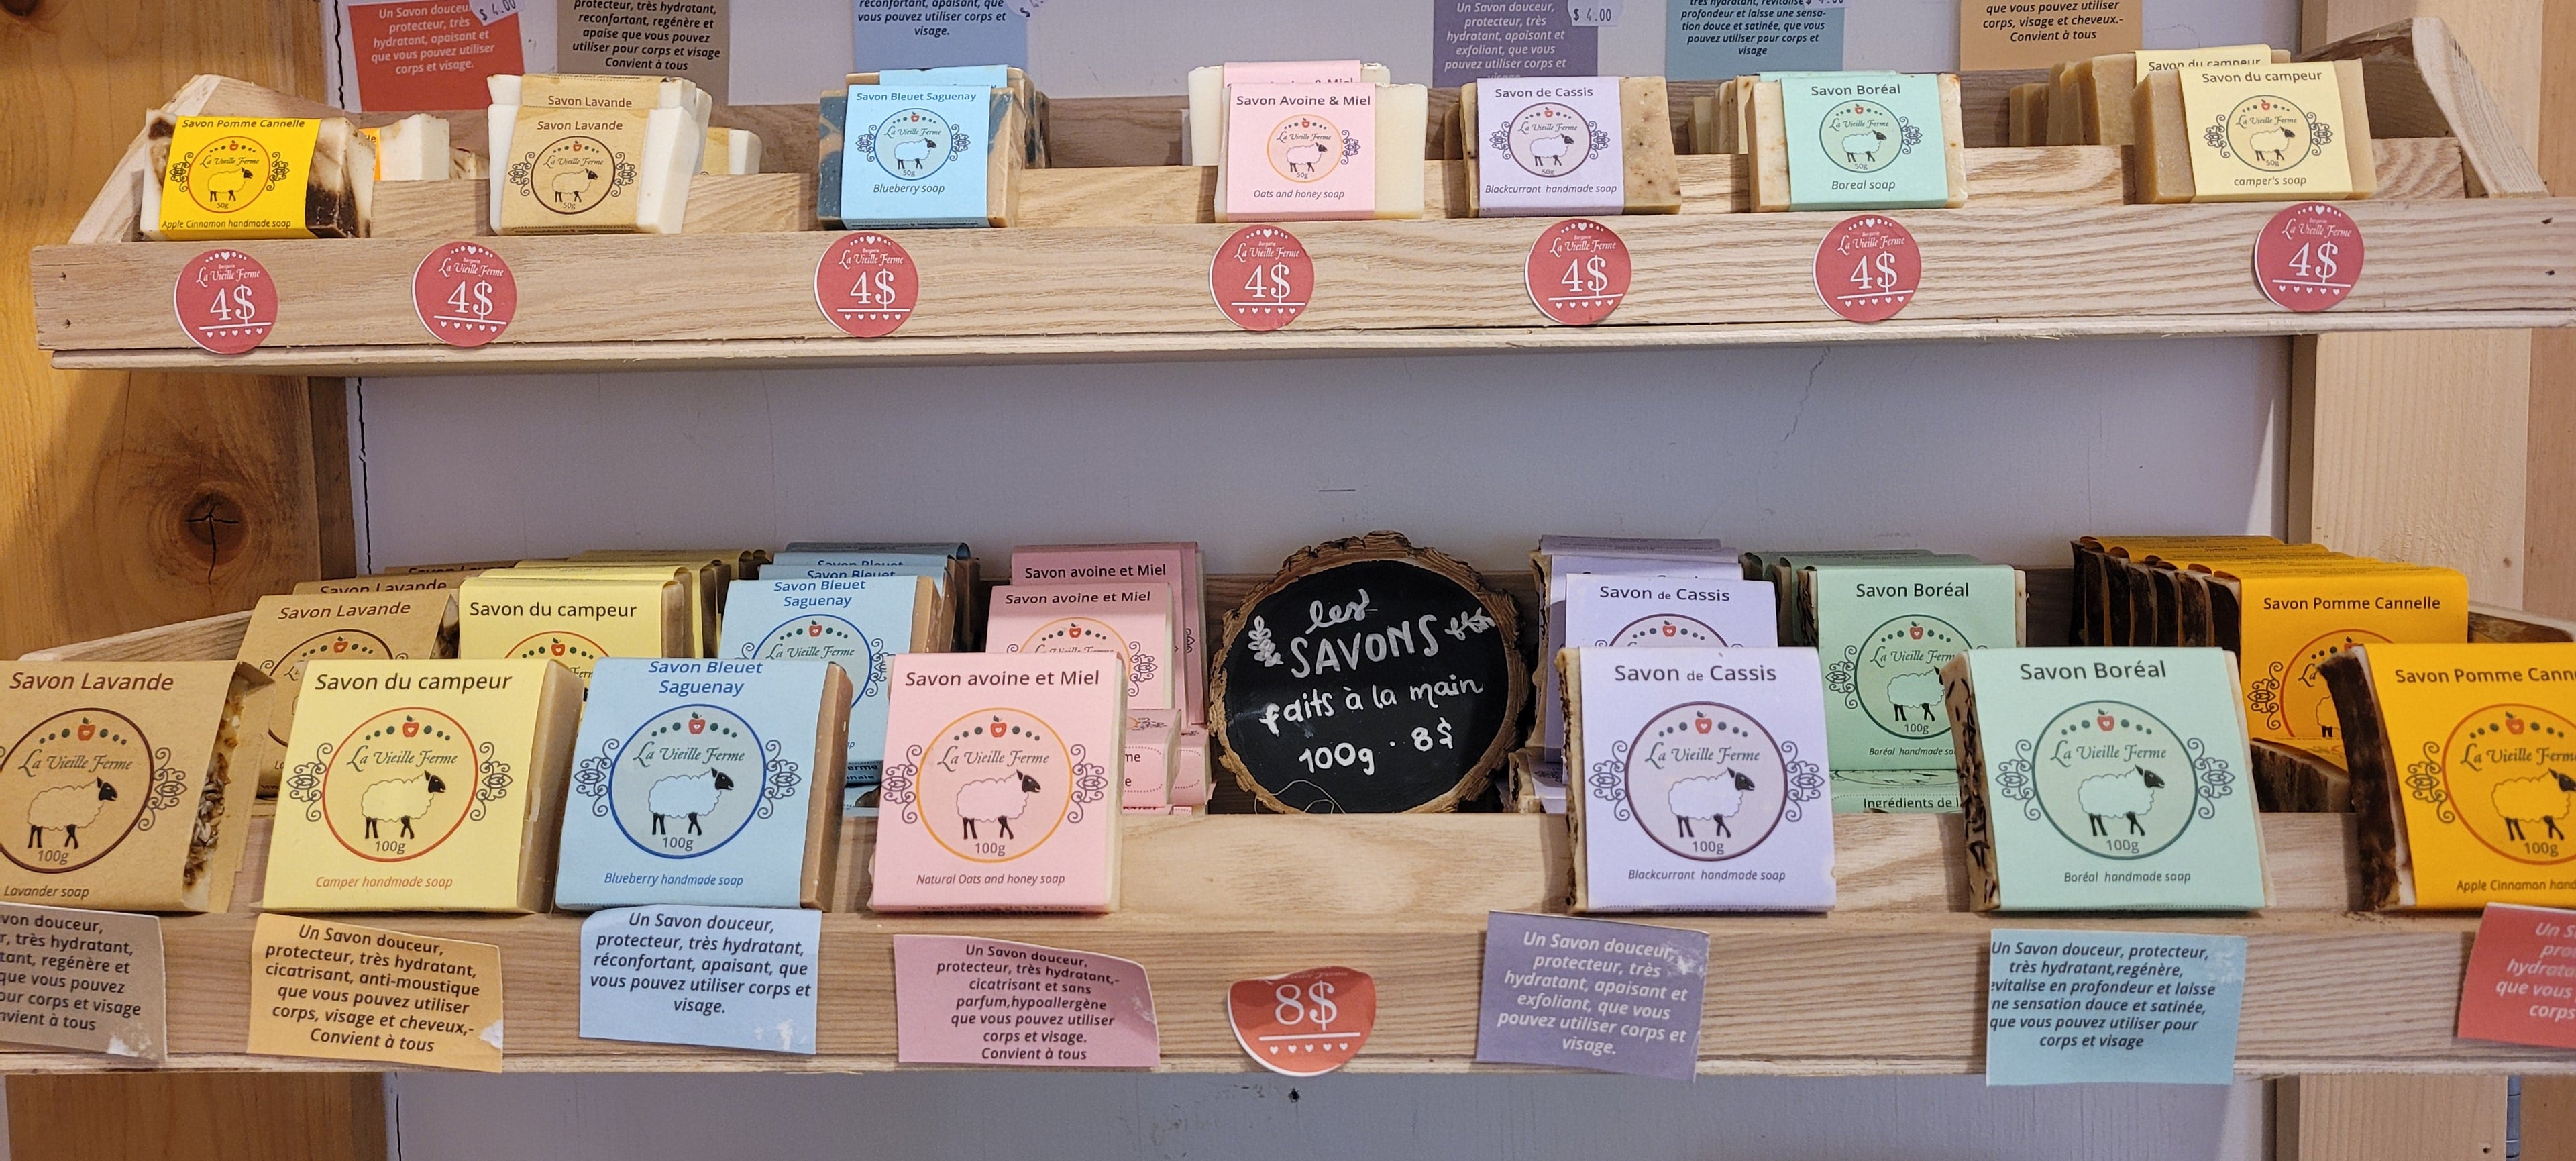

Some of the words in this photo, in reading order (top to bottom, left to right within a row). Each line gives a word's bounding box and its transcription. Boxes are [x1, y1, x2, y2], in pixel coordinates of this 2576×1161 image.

[1456, 2, 1472, 13] Un
[1474, 2, 1506, 13] Savon
[1508, 1, 1554, 13] douceur,
[1573, 8, 1580, 21] $
[1587, 7, 1611, 22] 4.00
[578, 13, 649, 27] reconfortant,
[703, 19, 714, 29] et
[857, 13, 882, 22] vous
[884, 13, 922, 24] pouvez
[925, 11, 962, 21] utiliser
[964, 13, 993, 24] corps
[996, 12, 1006, 21] et
[1982, 19, 2016, 31] corps,
[2019, 16, 2054, 30] visage
[2057, 16, 2069, 26] et
[914, 26, 950, 38] visage.
[1682, 21, 1701, 31] tion
[1703, 21, 1731, 30] douce
[1733, 22, 1743, 30] et
[1744, 20, 1780, 32] satinée,
[1783, 22, 1801, 32] que
[373, 35, 428, 50] hydratant,
[431, 31, 476, 46] apaisant
[478, 30, 489, 40] et
[1738, 46, 1768, 57] visage
[395, 64, 424, 76] corps
[426, 62, 437, 72] et
[439, 60, 474, 72] visage.
[605, 57, 653, 69] Convient
[655, 59, 662, 70] à
[665, 61, 688, 71] tous
[2202, 73, 2241, 83] Savon
[2244, 71, 2261, 82] du
[2265, 72, 2322, 83] campeur
[856, 93, 888, 101] Savon
[890, 92, 924, 101] Bleuet
[926, 93, 977, 103] Saguenay
[1495, 89, 1533, 98] Savon
[1536, 87, 1552, 97] de
[1555, 87, 1593, 97] Cassis
[1811, 86, 1852, 96] Savon
[1856, 83, 1900, 95] Boréal
[548, 95, 582, 106] Savon
[585, 96, 633, 108] Lavande
[1236, 95, 1276, 105] Savon
[1279, 95, 1326, 105] Avoine
[1329, 96, 1339, 105] &
[1343, 95, 1371, 106] Miel
[182, 119, 214, 128] Savon
[216, 119, 257, 128] Pomme
[260, 119, 305, 128] Cannelle
[536, 121, 572, 130] Savon
[574, 120, 623, 130] Lavande
[883, 125, 896, 139] La
[897, 128, 919, 136] Vieille
[918, 128, 942, 137] Ferme
[902, 169, 916, 178] 50g
[873, 183, 920, 195] Blueberry
[921, 185, 945, 195] soap
[1485, 184, 1542, 194] Blackcurrant
[1546, 183, 1594, 193] handmade
[1595, 185, 1617, 195] soap
[1831, 179, 1867, 190] Boreal
[1869, 181, 1896, 192] soap
[2233, 176, 2279, 188] camper's
[2282, 177, 2307, 187] soap
[1253, 189, 1274, 198] Oats
[1275, 189, 1293, 198] and
[1295, 189, 1322, 201] honey
[1323, 191, 1345, 200] soap
[216, 202, 229, 210] 50g
[162, 219, 184, 229] Apple
[186, 220, 226, 228] Cinnamon
[228, 219, 270, 228] handmade
[272, 221, 291, 229] soap
[2288, 241, 2339, 285] 4$
[195, 266, 209, 288] La
[209, 269, 235, 281] Vieille
[235, 268, 260, 283] Ferme
[1560, 254, 1609, 296] 4$
[1849, 251, 1898, 293] 4$
[849, 268, 897, 309] 4$
[1244, 262, 1291, 303] 4$
[209, 283, 256, 325] 4$
[447, 279, 494, 321] 4$
[1006, 594, 1047, 604] Savon
[1052, 593, 1099, 603] avoine
[1103, 593, 1117, 602] et
[1121, 591, 1150, 602] Miel
[1599, 586, 1652, 599] Savon
[1657, 591, 1671, 600] de
[1676, 588, 1730, 602] Cassis
[1856, 583, 1907, 597] Savon
[1914, 582, 1969, 597] Boréal
[278, 607, 331, 619] Savon
[336, 601, 411, 617] Lavande
[470, 601, 524, 617] Savon
[529, 601, 551, 616] du
[557, 605, 637, 621] campeur
[2263, 597, 2308, 610] Savon
[2313, 597, 2370, 610] Pomme
[2375, 596, 2440, 609] Cannelle
[1291, 614, 1439, 678] SAVONS
[648, 660, 701, 674] Savon
[706, 660, 763, 674] Bleuet
[1615, 665, 1680, 682] Savon
[1686, 670, 1703, 682] de
[1710, 664, 1776, 681] Cassis
[2020, 663, 2087, 680] Savon
[2093, 660, 2166, 679] Boréal
[9, 672, 75, 689] Savon
[80, 672, 174, 691] Lavande
[315, 674, 378, 690] Savon
[384, 672, 411, 690] du
[418, 676, 513, 695] campeur
[905, 672, 961, 687] Savon
[967, 670, 1030, 686] avoine
[1036, 672, 1055, 685] et
[1061, 670, 1099, 685] Miel
[658, 680, 745, 697] Saguenay
[1258, 688, 1334, 738] faits
[1343, 686, 1364, 711] à
[1372, 684, 1397, 709] la
[1409, 674, 1484, 709] main
[1298, 742, 1375, 776] 100g
[1411, 717, 1453, 752] 8$
[1644, 741, 1666, 770] La
[1670, 747, 1714, 762] Vieille
[1716, 746, 1760, 765] Ferme
[662, 836, 694, 852] 100g
[1692, 840, 1725, 856] 100g
[38, 850, 70, 866] 100g
[315, 876, 360, 891] Camper
[362, 876, 423, 887] handmade
[425, 878, 453, 891] soap
[2064, 871, 2098, 882] Boréal
[2104, 870, 2162, 882] handmade
[2165, 872, 2191, 885] soap
[3, 885, 60, 897] Lavander
[60, 888, 89, 901] soap
[266, 962, 354, 985] cicatrisant,
[701, 958, 773, 976] apaisant,
[779, 964, 808, 979] que
[1275, 980, 1338, 1032] 8$
[1562, 1036, 1616, 1057] visage.
[2039, 1036, 2078, 1050] corps
[2082, 1035, 2096, 1047] et
[2100, 1034, 2144, 1050] visage
